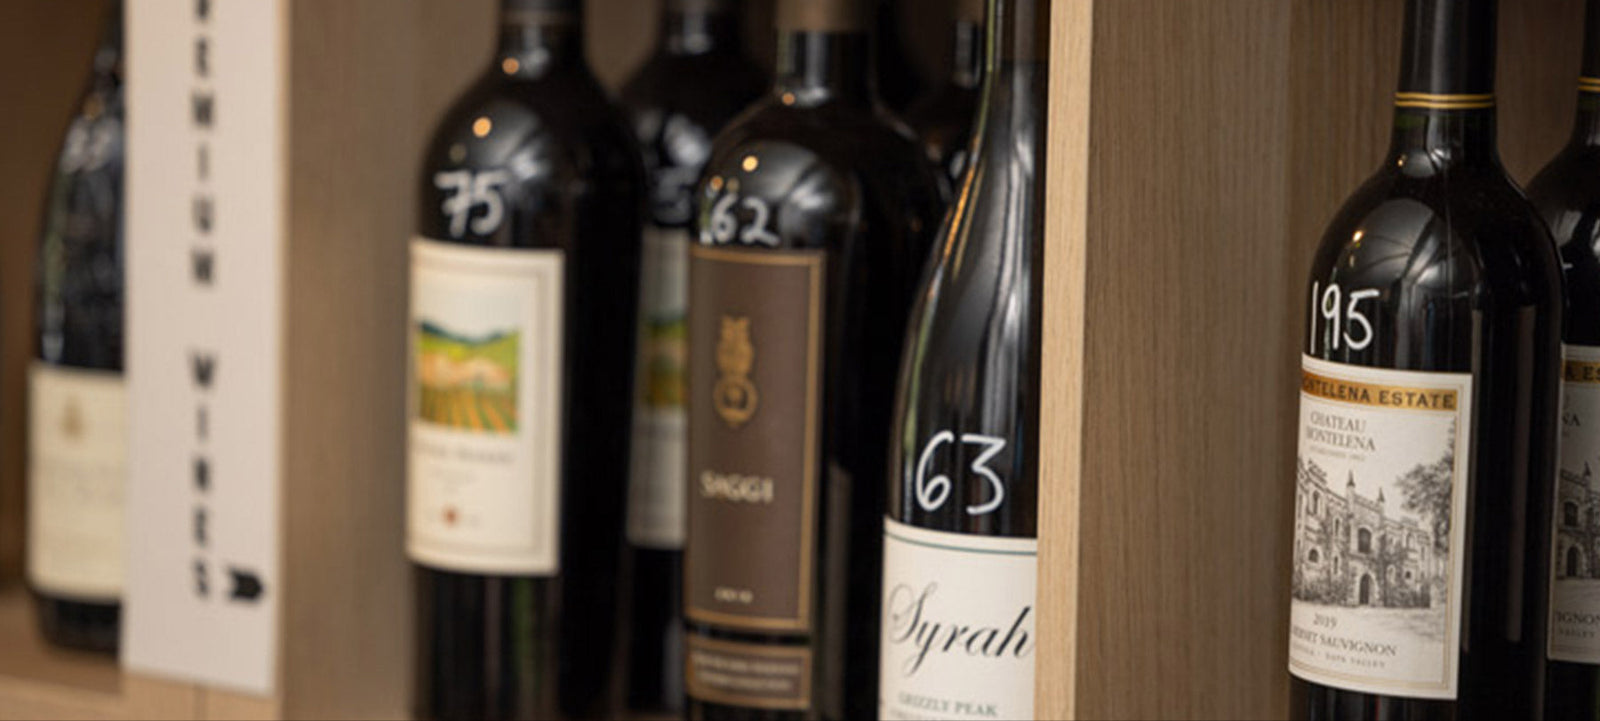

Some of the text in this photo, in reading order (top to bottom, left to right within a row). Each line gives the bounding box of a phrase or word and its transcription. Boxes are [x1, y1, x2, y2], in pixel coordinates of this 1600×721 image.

[434, 169, 507, 238] 75
[711, 192, 780, 246] 62
[1310, 281, 1381, 355] 195
[1310, 410, 1367, 433] CHATEAU
[1378, 389, 1456, 409] ESTATE
[189, 352, 217, 598] WINES
[915, 429, 1007, 515] 63
[888, 581, 1035, 677] Syrah
[1319, 634, 1397, 657] SAUVIGNON
[955, 700, 998, 718] PEAK
